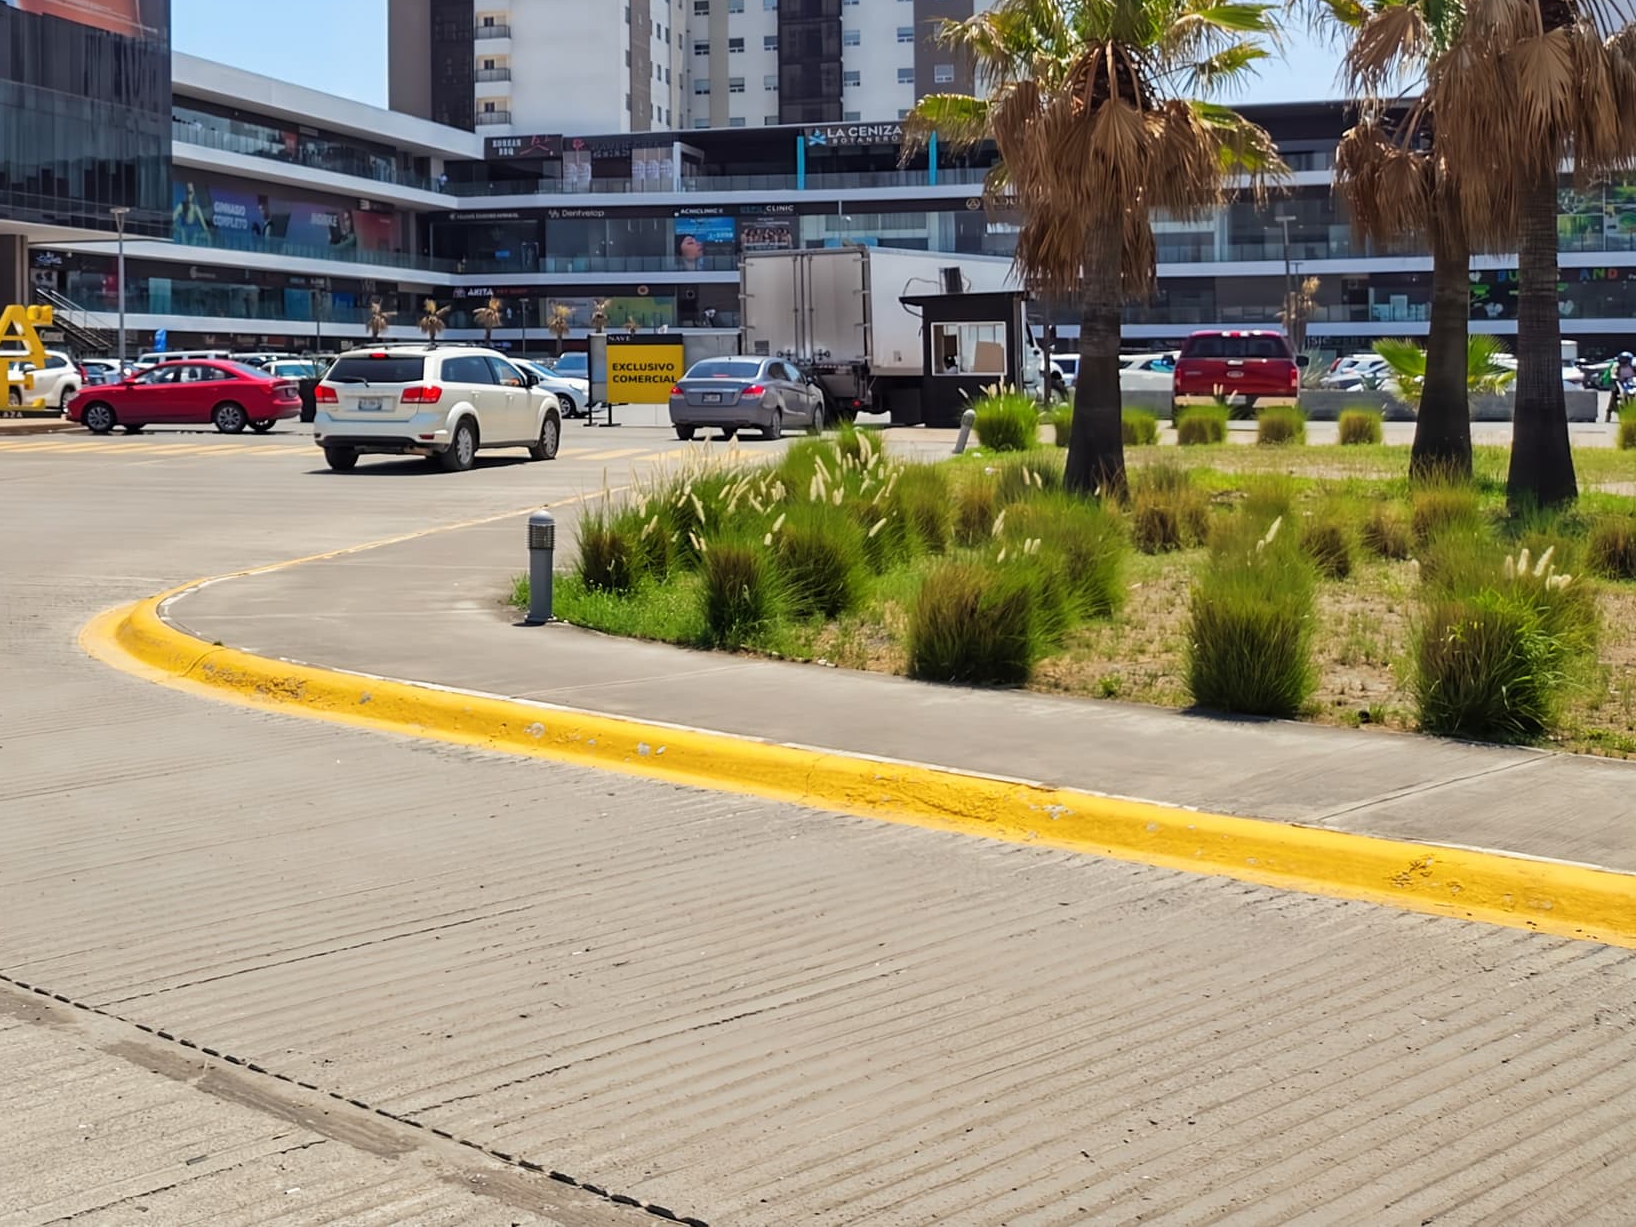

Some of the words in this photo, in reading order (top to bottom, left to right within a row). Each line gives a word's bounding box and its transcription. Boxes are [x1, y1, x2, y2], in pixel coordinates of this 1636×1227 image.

[827, 128, 845, 138] LA
[848, 124, 902, 137] CENIZA
[832, 135, 899, 144] BOTANERO
[561, 209, 605, 218] Dentvelop
[468, 287, 493, 296] AKITA
[612, 363, 675, 371] EXCLUSIVO
[612, 375, 678, 384] COMERCIAL
